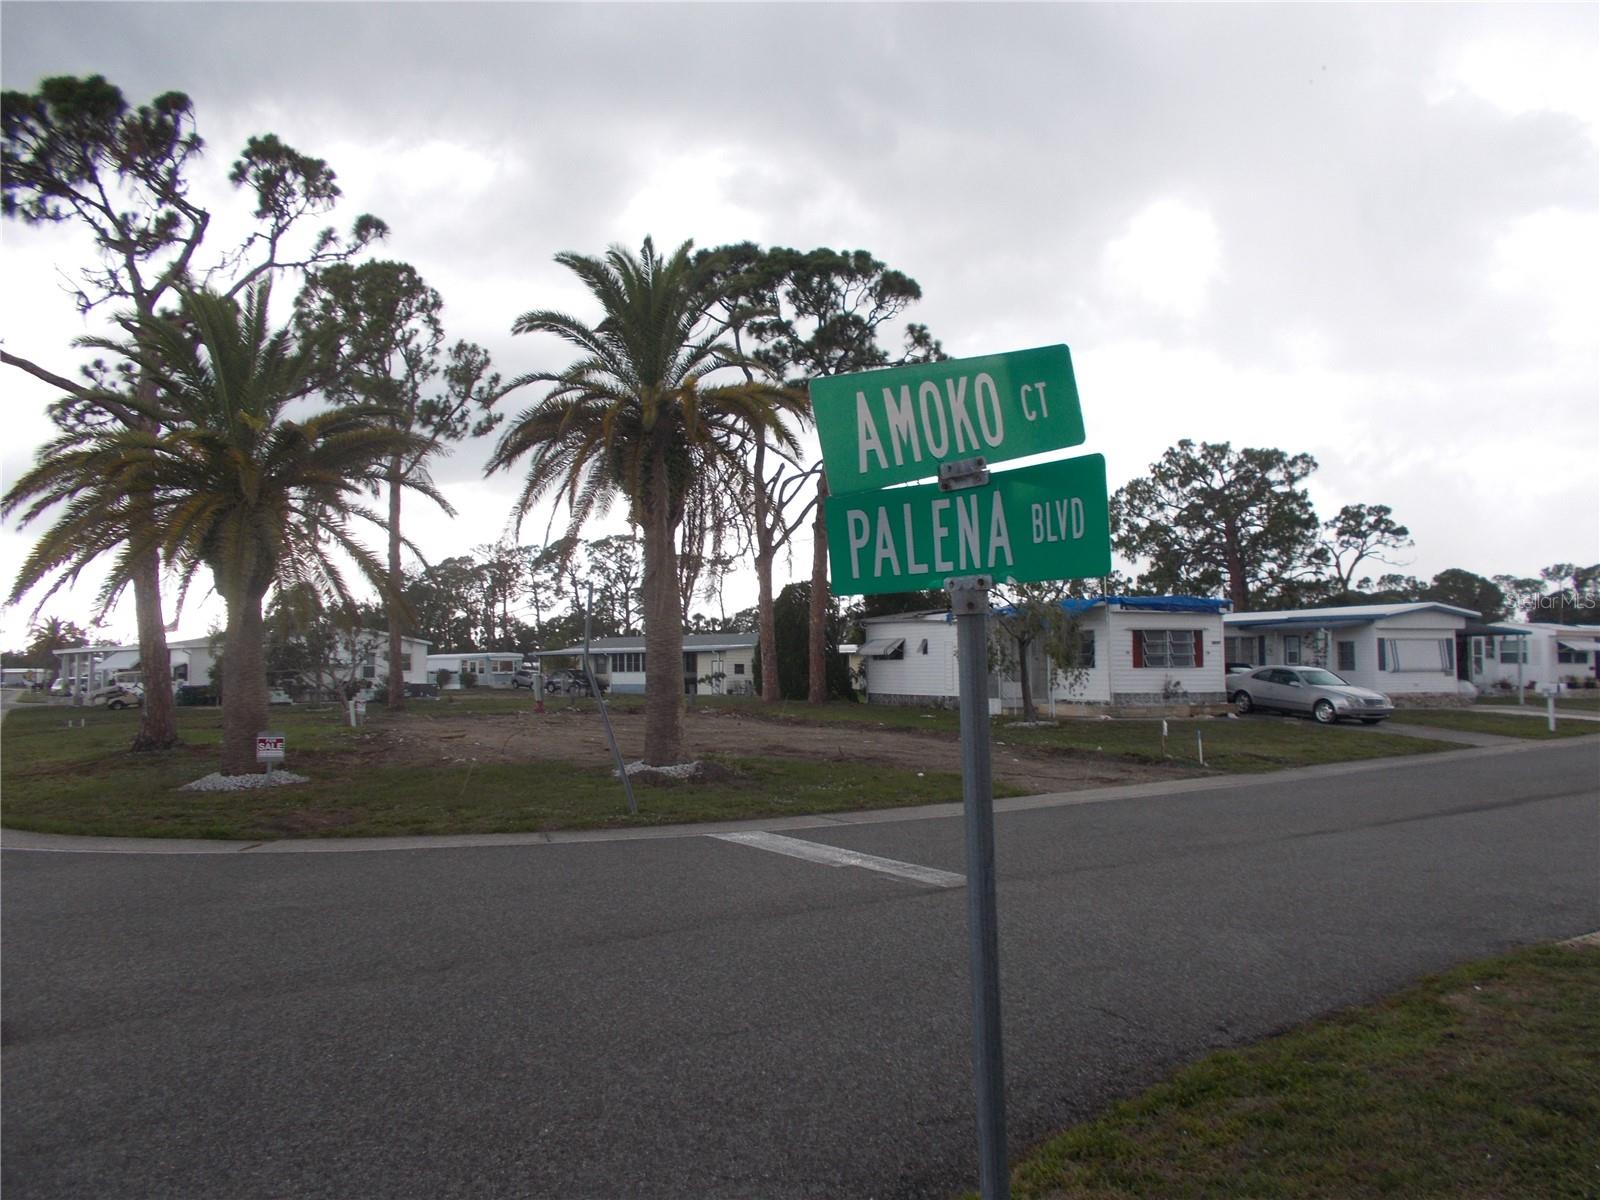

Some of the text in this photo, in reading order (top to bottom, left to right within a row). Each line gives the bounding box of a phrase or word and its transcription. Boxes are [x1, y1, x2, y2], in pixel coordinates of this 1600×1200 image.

[855, 372, 1048, 474] AMOKO CT
[846, 490, 1085, 579] PALENA BLVD
[257, 742, 283, 751] SALE
